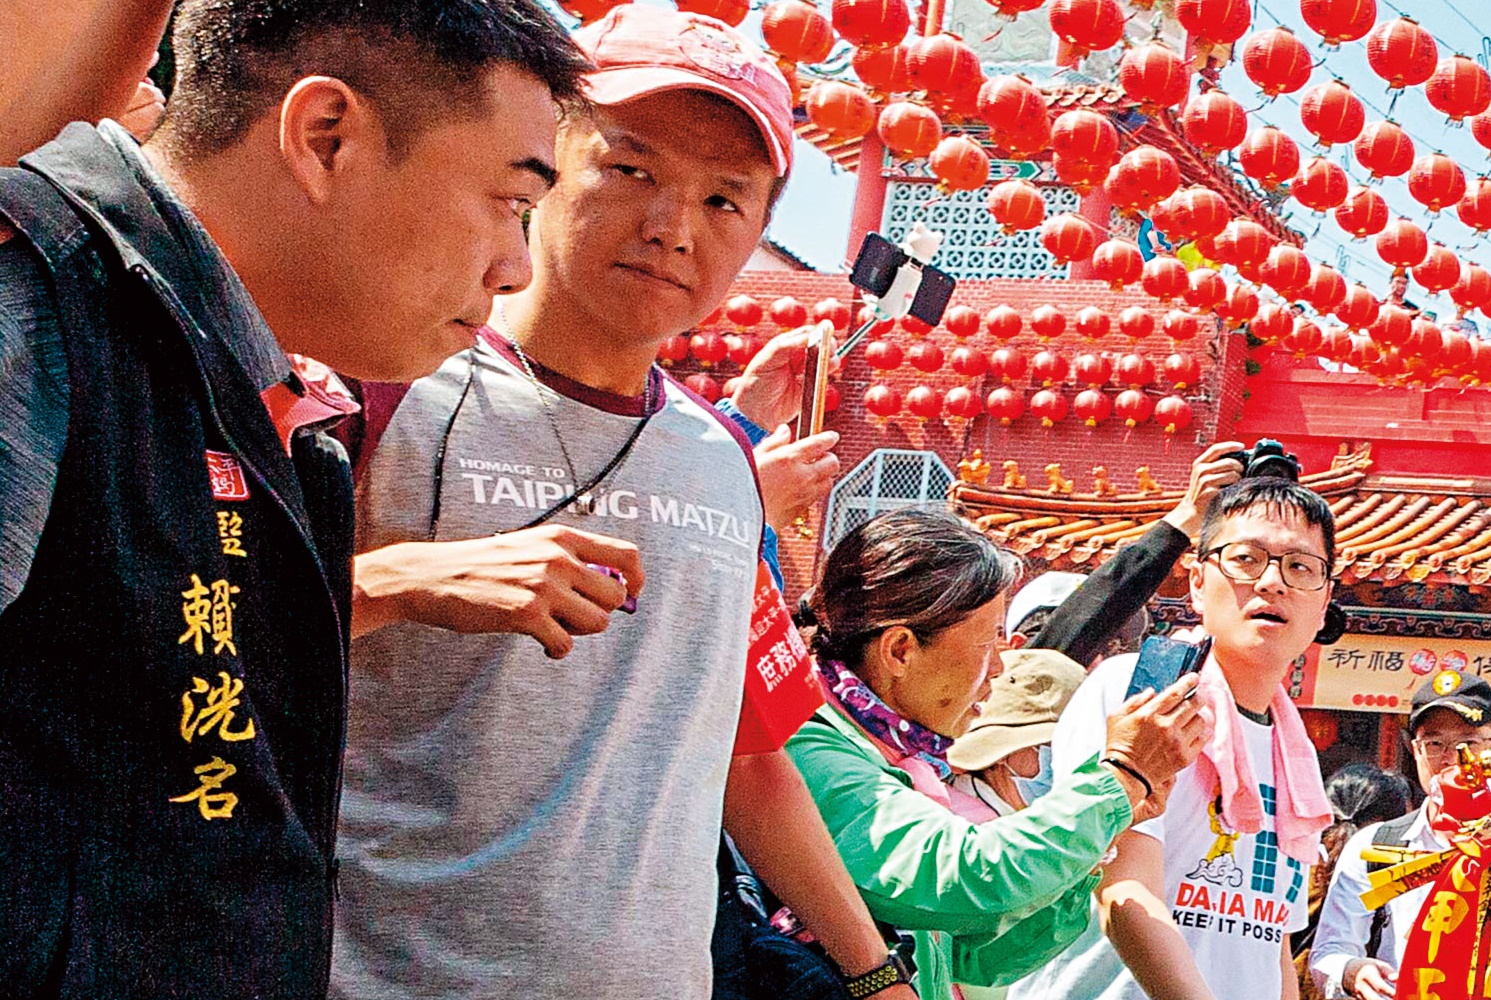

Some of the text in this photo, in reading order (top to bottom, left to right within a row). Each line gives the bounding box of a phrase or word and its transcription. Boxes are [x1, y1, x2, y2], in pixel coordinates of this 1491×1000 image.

[460, 458, 565, 478] HOMAGE TO
[650, 495, 750, 548] MATZU
[1175, 882, 1246, 918] DAIA
[1173, 909, 1213, 929] KEE
[1218, 918, 1236, 934] IT
